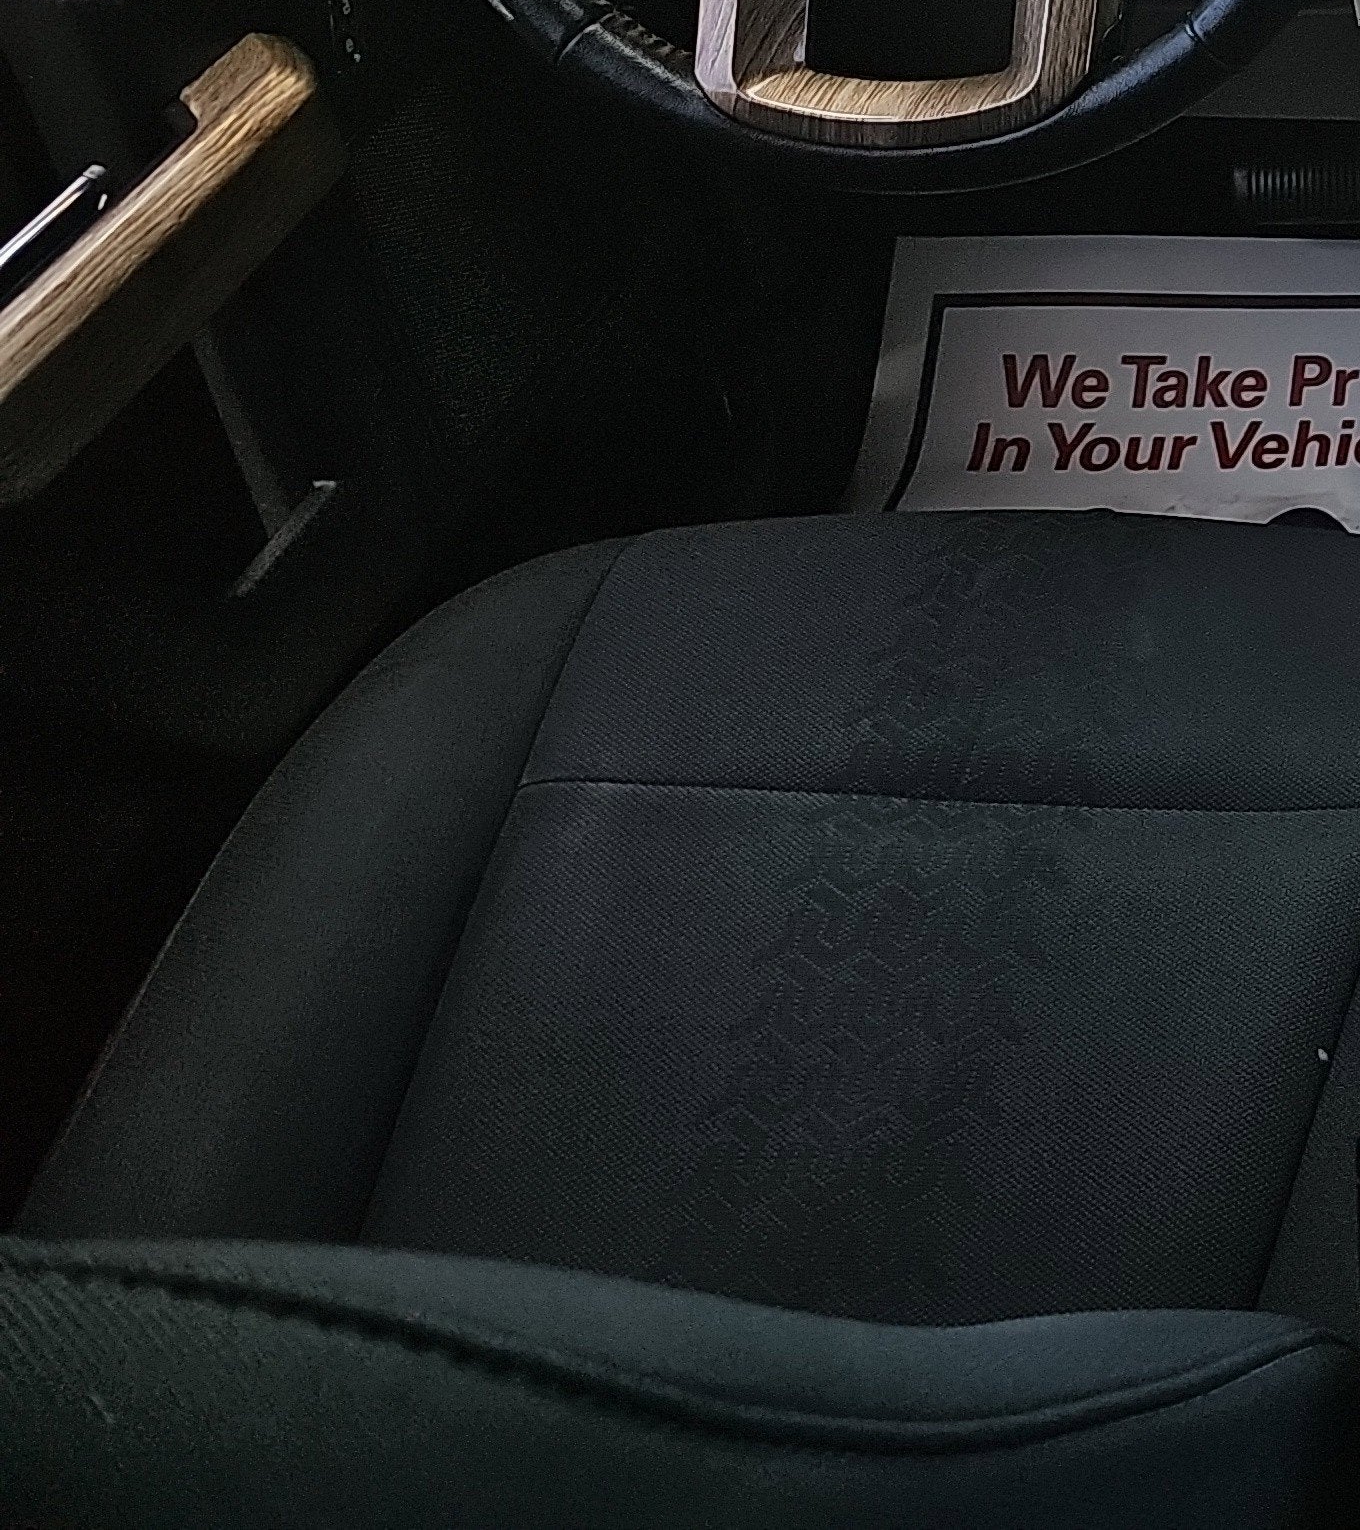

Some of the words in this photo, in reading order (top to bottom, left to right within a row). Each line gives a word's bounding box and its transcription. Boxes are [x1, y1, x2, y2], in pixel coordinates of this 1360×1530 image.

[1001, 352, 1111, 411] We
[1122, 353, 1269, 410] Take
[965, 421, 1032, 473] In
[1048, 421, 1200, 472] Your
